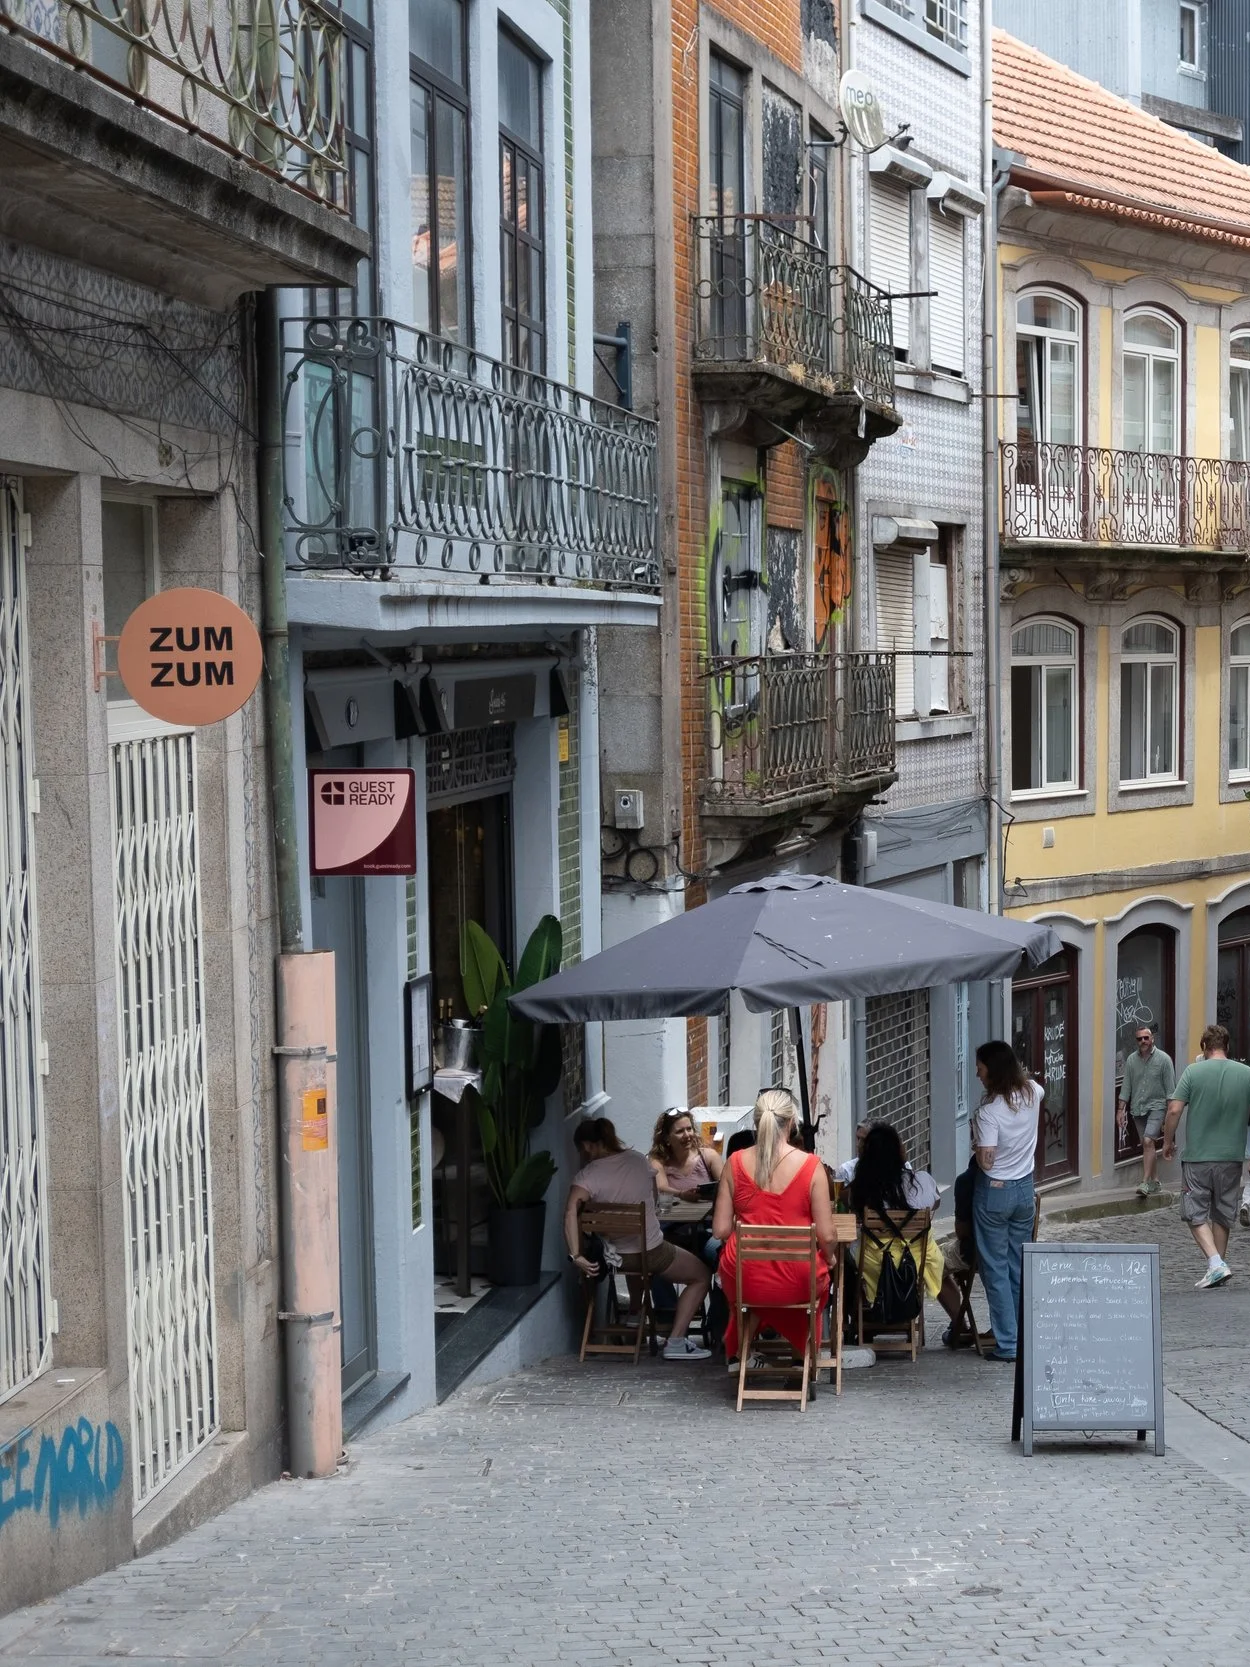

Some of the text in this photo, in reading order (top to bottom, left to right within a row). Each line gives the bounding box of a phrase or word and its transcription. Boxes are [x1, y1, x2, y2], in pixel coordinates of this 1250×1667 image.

[846, 86, 873, 106] meo
[150, 626, 233, 652] ZUM
[151, 661, 234, 687] ZUM
[349, 781, 395, 793] GUEST
[349, 794, 396, 805] READY
[1039, 1258, 1074, 1274] Menu
[1081, 1256, 1114, 1273] Pasta
[1054, 1395, 1076, 1410] Only
